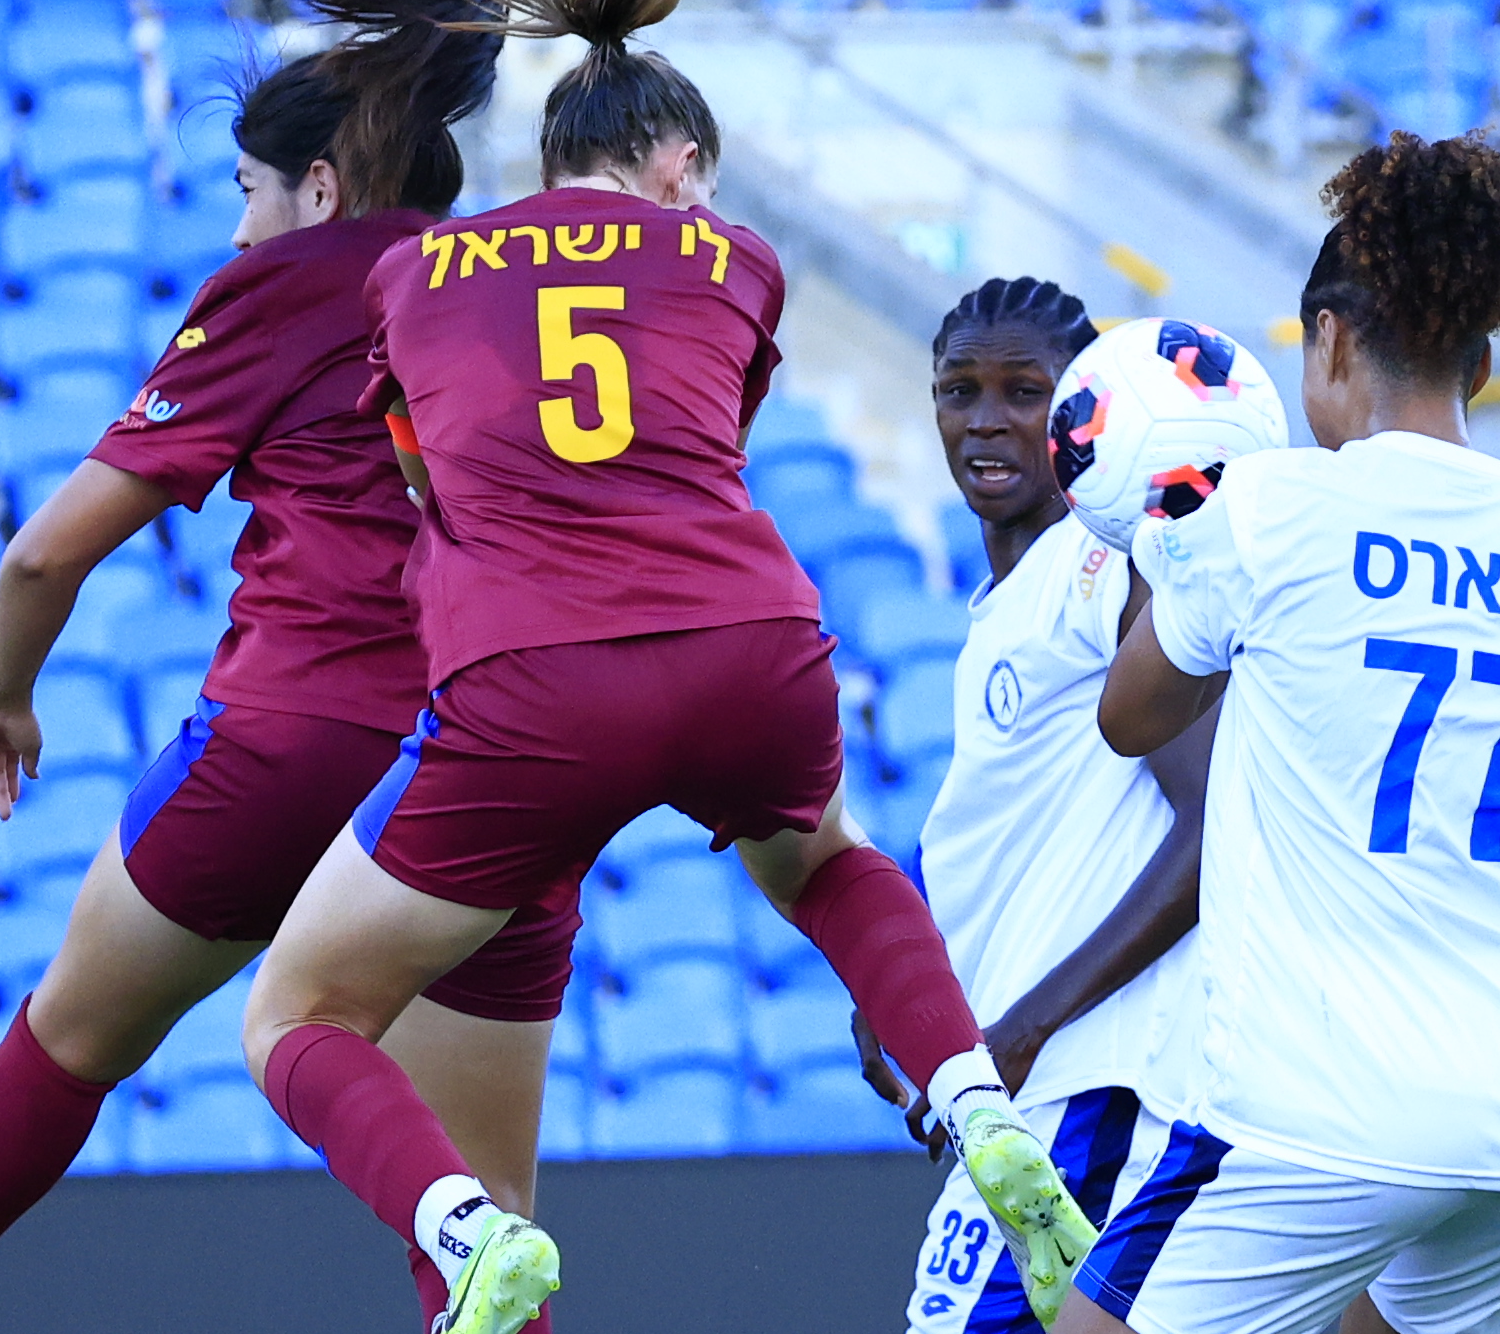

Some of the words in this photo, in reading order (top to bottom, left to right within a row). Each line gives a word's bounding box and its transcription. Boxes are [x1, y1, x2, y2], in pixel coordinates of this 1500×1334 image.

[421, 223, 642, 290] ישראל
[679, 217, 731, 285] לי
[536, 285, 635, 464] 5
[926, 1209, 989, 1285] 33
